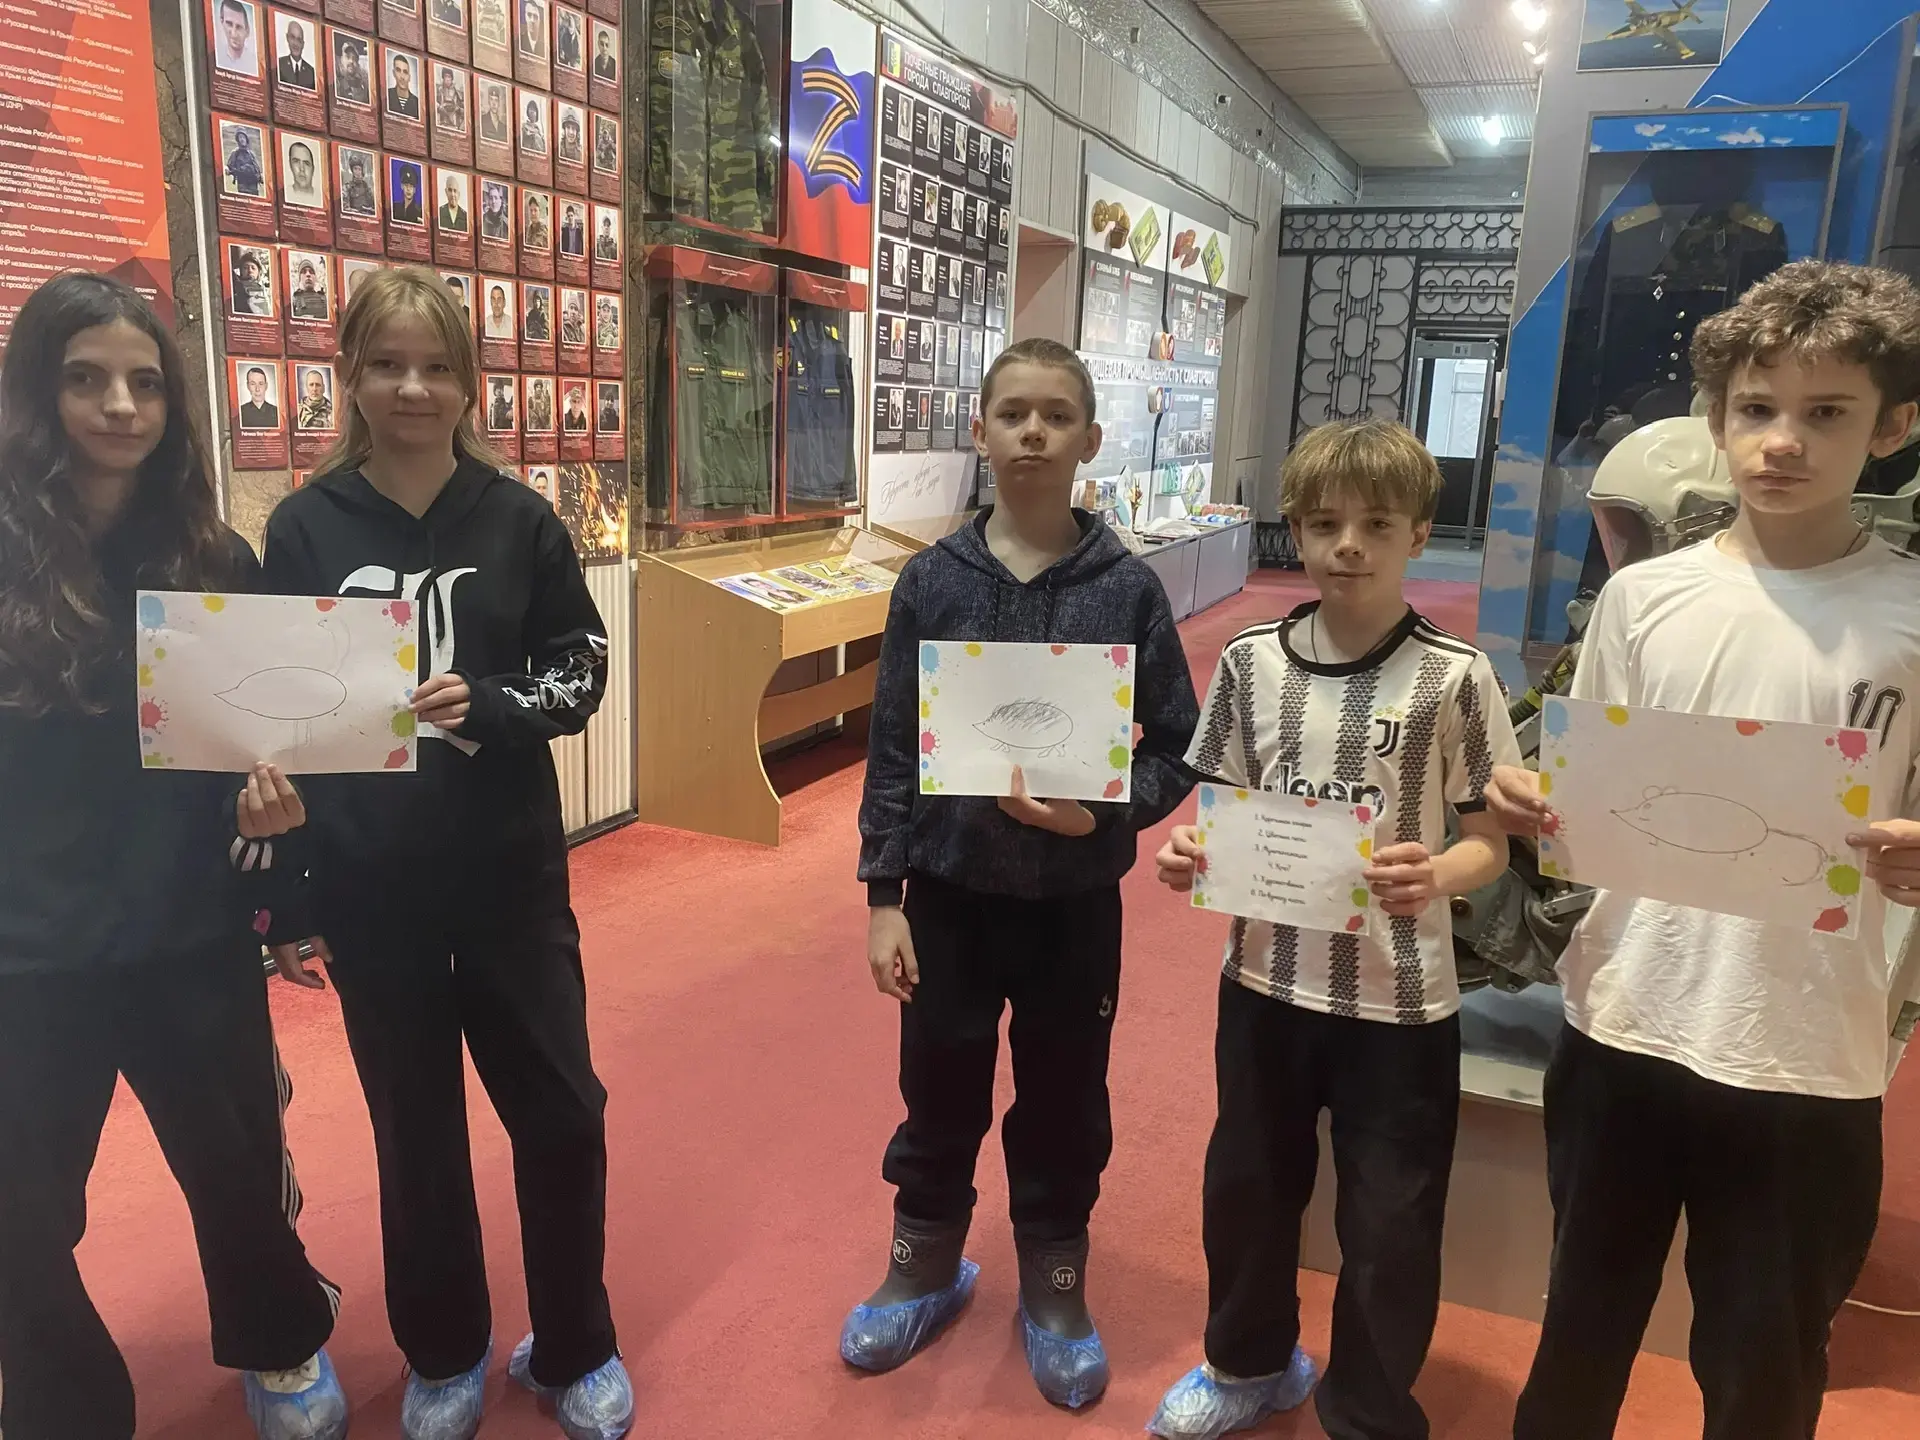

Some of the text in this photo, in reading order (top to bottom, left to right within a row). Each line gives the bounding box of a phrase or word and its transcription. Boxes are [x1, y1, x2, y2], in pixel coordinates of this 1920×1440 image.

[904, 51, 972, 97] ПОЧЕТНЫЕ ГРАЖДАНЕ
[904, 66, 970, 110] ГОРОДА СЛАВГОРОДА
[1847, 678, 1905, 752] 10
